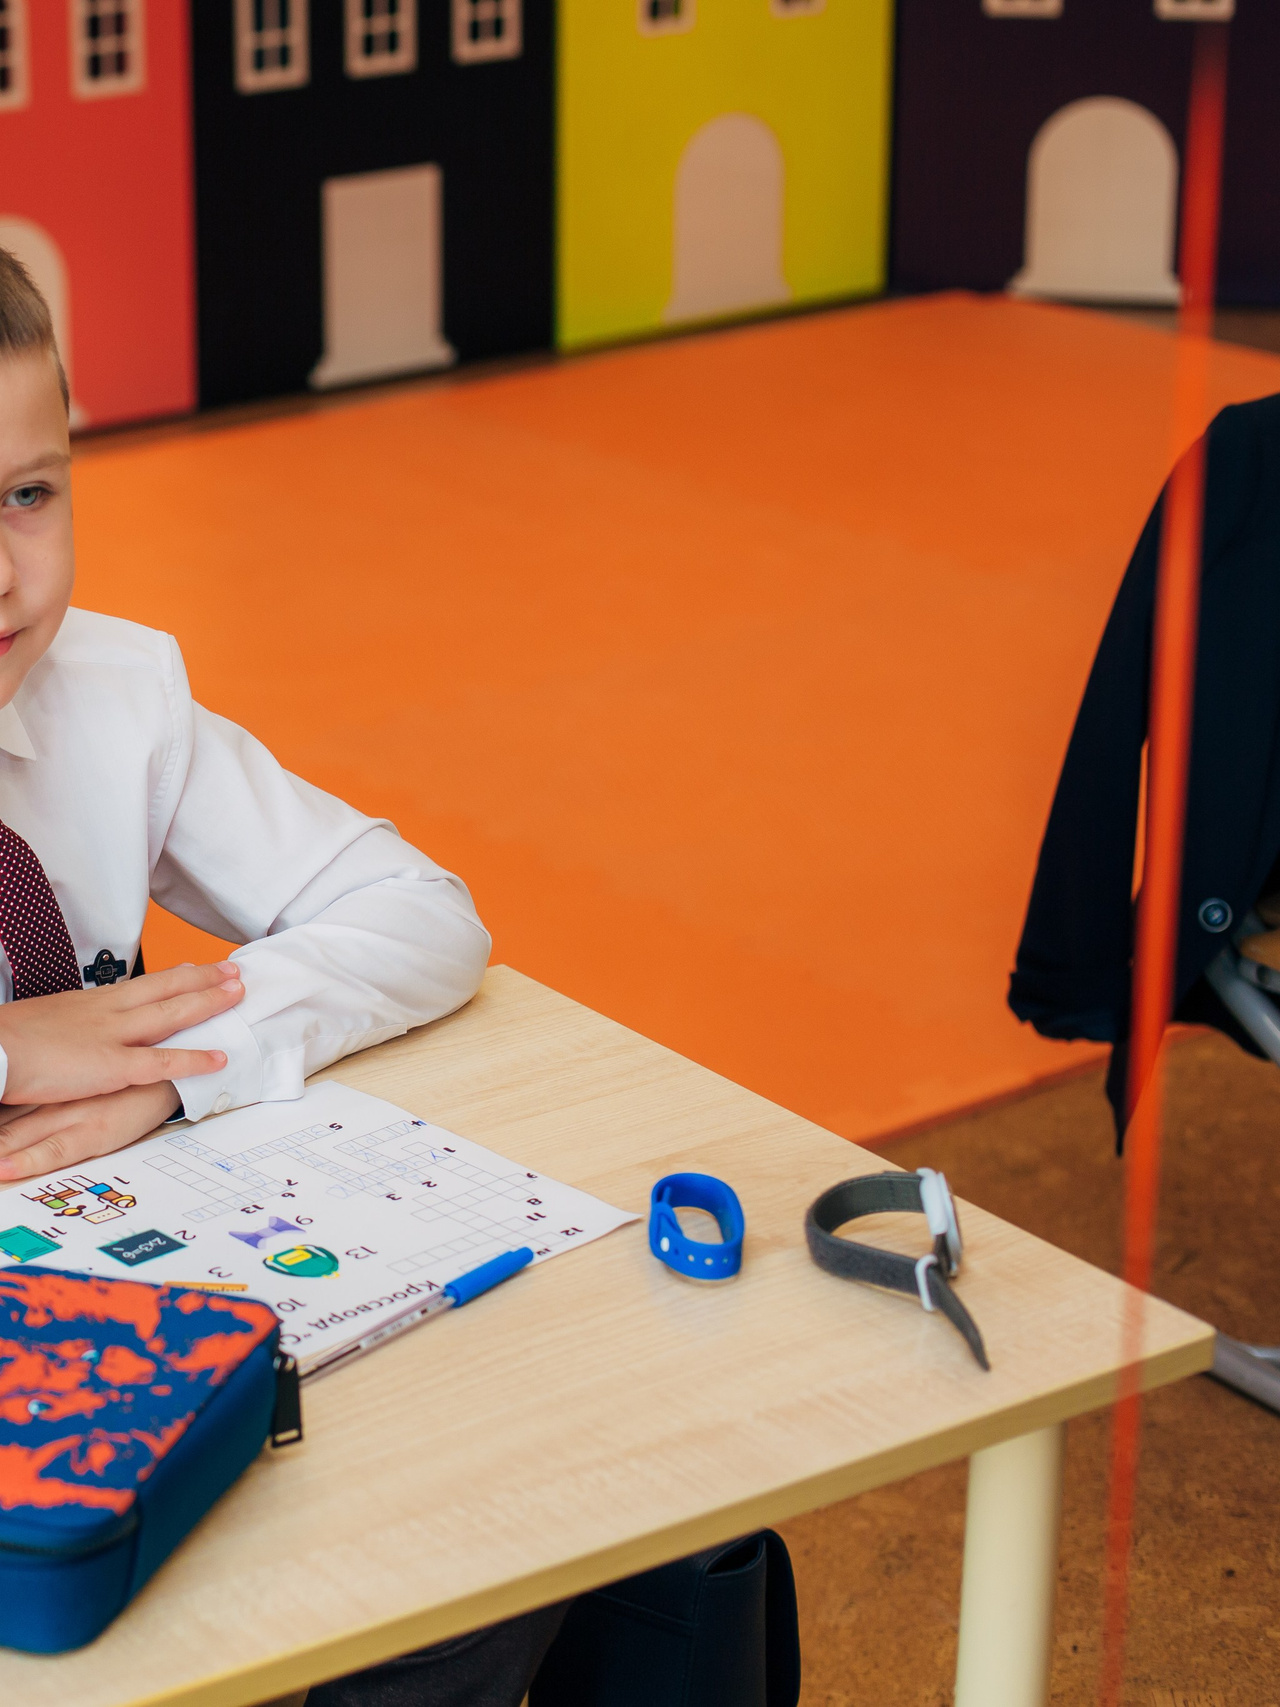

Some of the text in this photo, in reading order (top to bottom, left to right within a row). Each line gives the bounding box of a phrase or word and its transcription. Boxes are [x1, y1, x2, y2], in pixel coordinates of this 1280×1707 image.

[328, 1122, 344, 1131] 5
[442, 1146, 457, 1154] 1
[112, 1175, 131, 1185] 1
[285, 1178, 299, 1187] 7
[421, 1180, 438, 1188] 2
[385, 1193, 403, 1201] 3
[525, 1197, 543, 1206] 8
[239, 1204, 265, 1215] 13
[294, 1214, 314, 1226] 9
[525, 1211, 547, 1222] 11
[41, 1226, 68, 1239] 11
[173, 1229, 197, 1241] 2
[559, 1226, 584, 1237] 12
[344, 1245, 378, 1260] 13
[207, 1265, 233, 1279] 3
[276, 1297, 307, 1313] 10
[307, 1279, 441, 1332] Кроссворд
